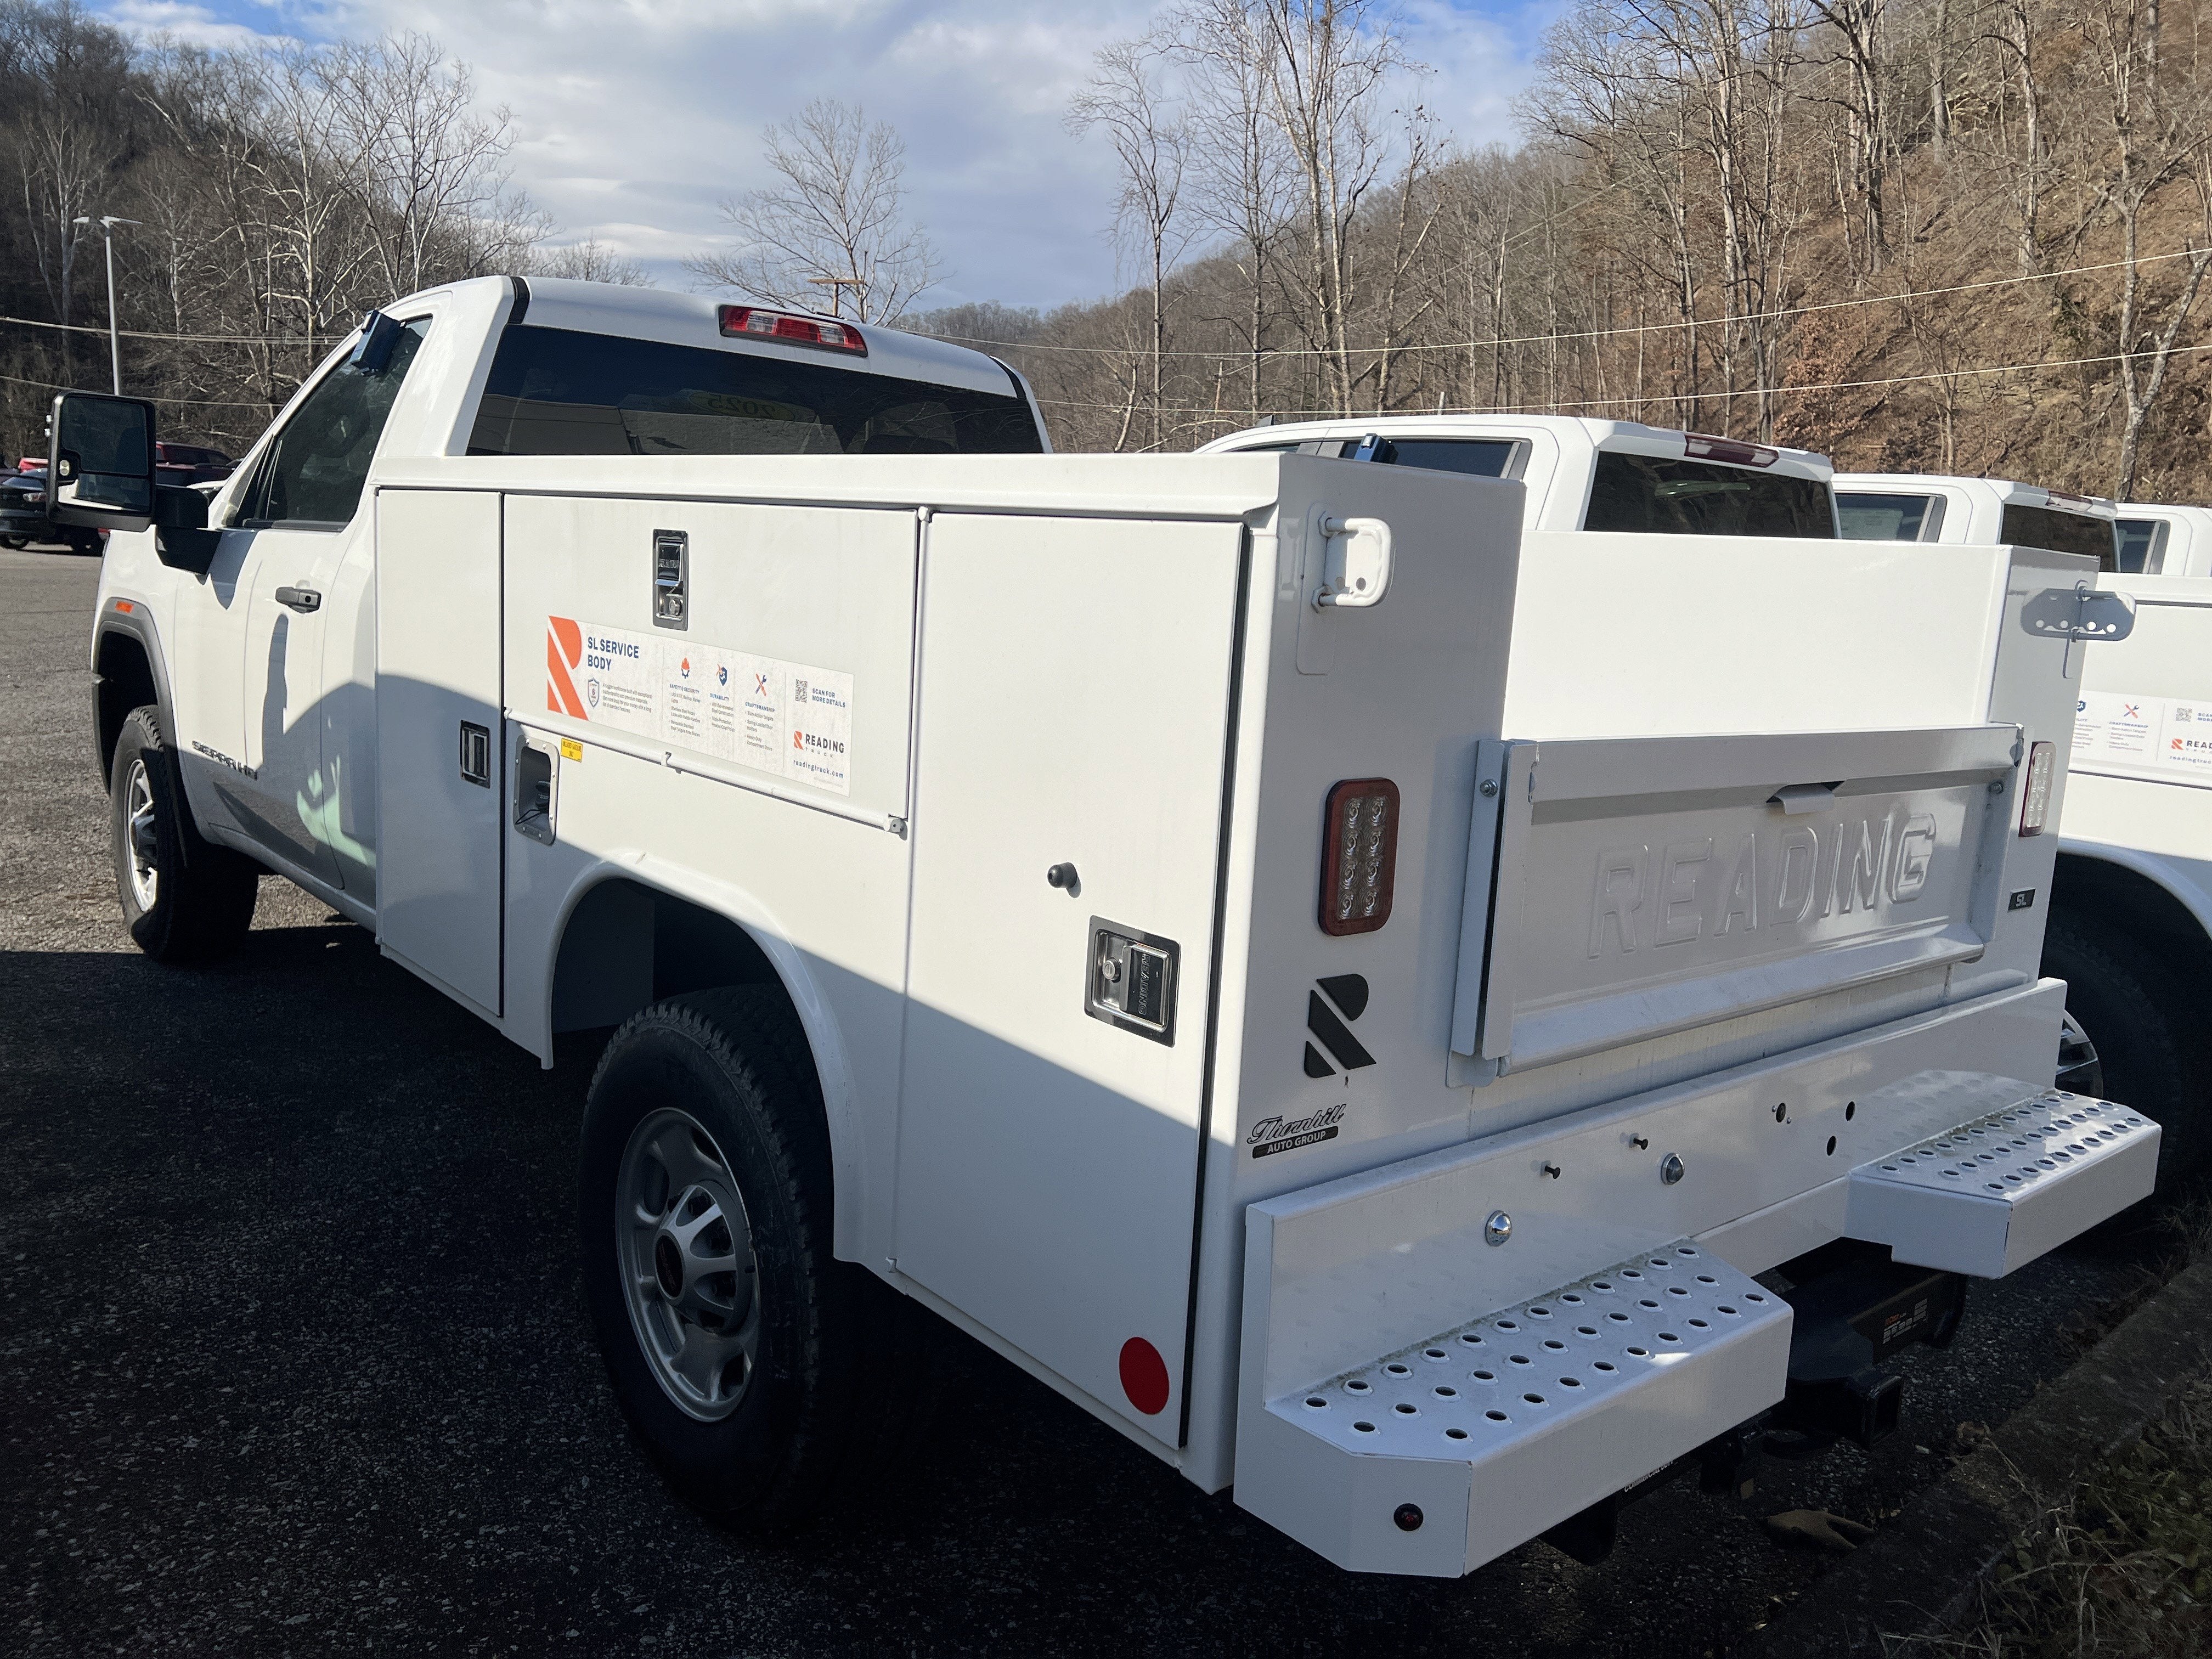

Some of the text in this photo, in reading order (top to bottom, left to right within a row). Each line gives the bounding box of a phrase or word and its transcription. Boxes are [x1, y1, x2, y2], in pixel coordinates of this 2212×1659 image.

[588, 636, 639, 659] SL SERVICE
[588, 654, 612, 671] BODY
[710, 693, 729, 702] DURABILITY
[812, 688, 825, 696] SCAN
[812, 695, 846, 708] MORE DETAILS
[805, 733, 844, 753] READING
[805, 747, 833, 758] TRUCK
[793, 759, 844, 778] readingtruck.com
[1588, 812, 1936, 961] READING
[2016, 893, 2027, 907] SL
[1138, 953, 1152, 1015] READING
[1246, 1103, 1347, 1144] Thornhill
[1267, 1130, 1326, 1154] AUTO GROUP
